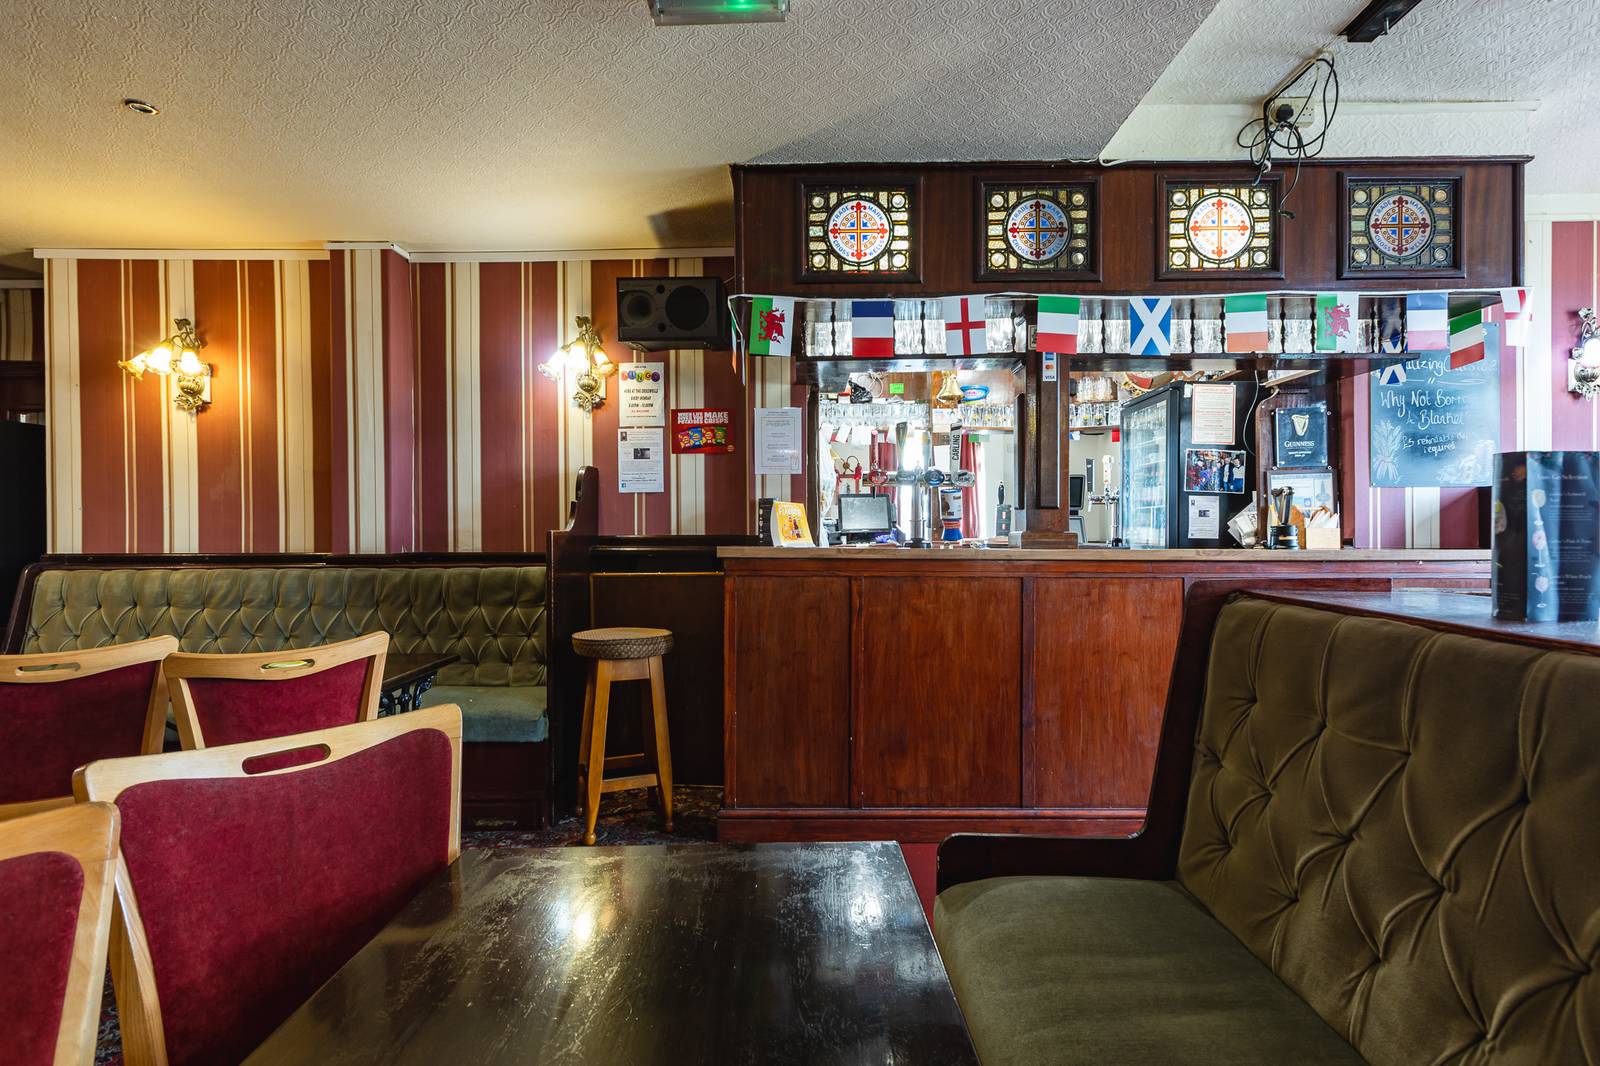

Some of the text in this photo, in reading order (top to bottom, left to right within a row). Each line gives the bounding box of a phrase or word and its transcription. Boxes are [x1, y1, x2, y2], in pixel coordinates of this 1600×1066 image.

[832, 205, 884, 223] TRADE MARK
[1011, 203, 1064, 221] TRADE MARK
[1374, 200, 1426, 217] TRADE MARK
[833, 239, 885, 257] CROSS WELLS
[1012, 239, 1064, 256] CROSS WELLS
[1374, 234, 1426, 252] CROSS WELLS
[1380, 389, 1406, 418] Why
[1411, 389, 1432, 408] Not
[951, 433, 961, 461] CARLING
[1284, 440, 1316, 448] GUINNESS
